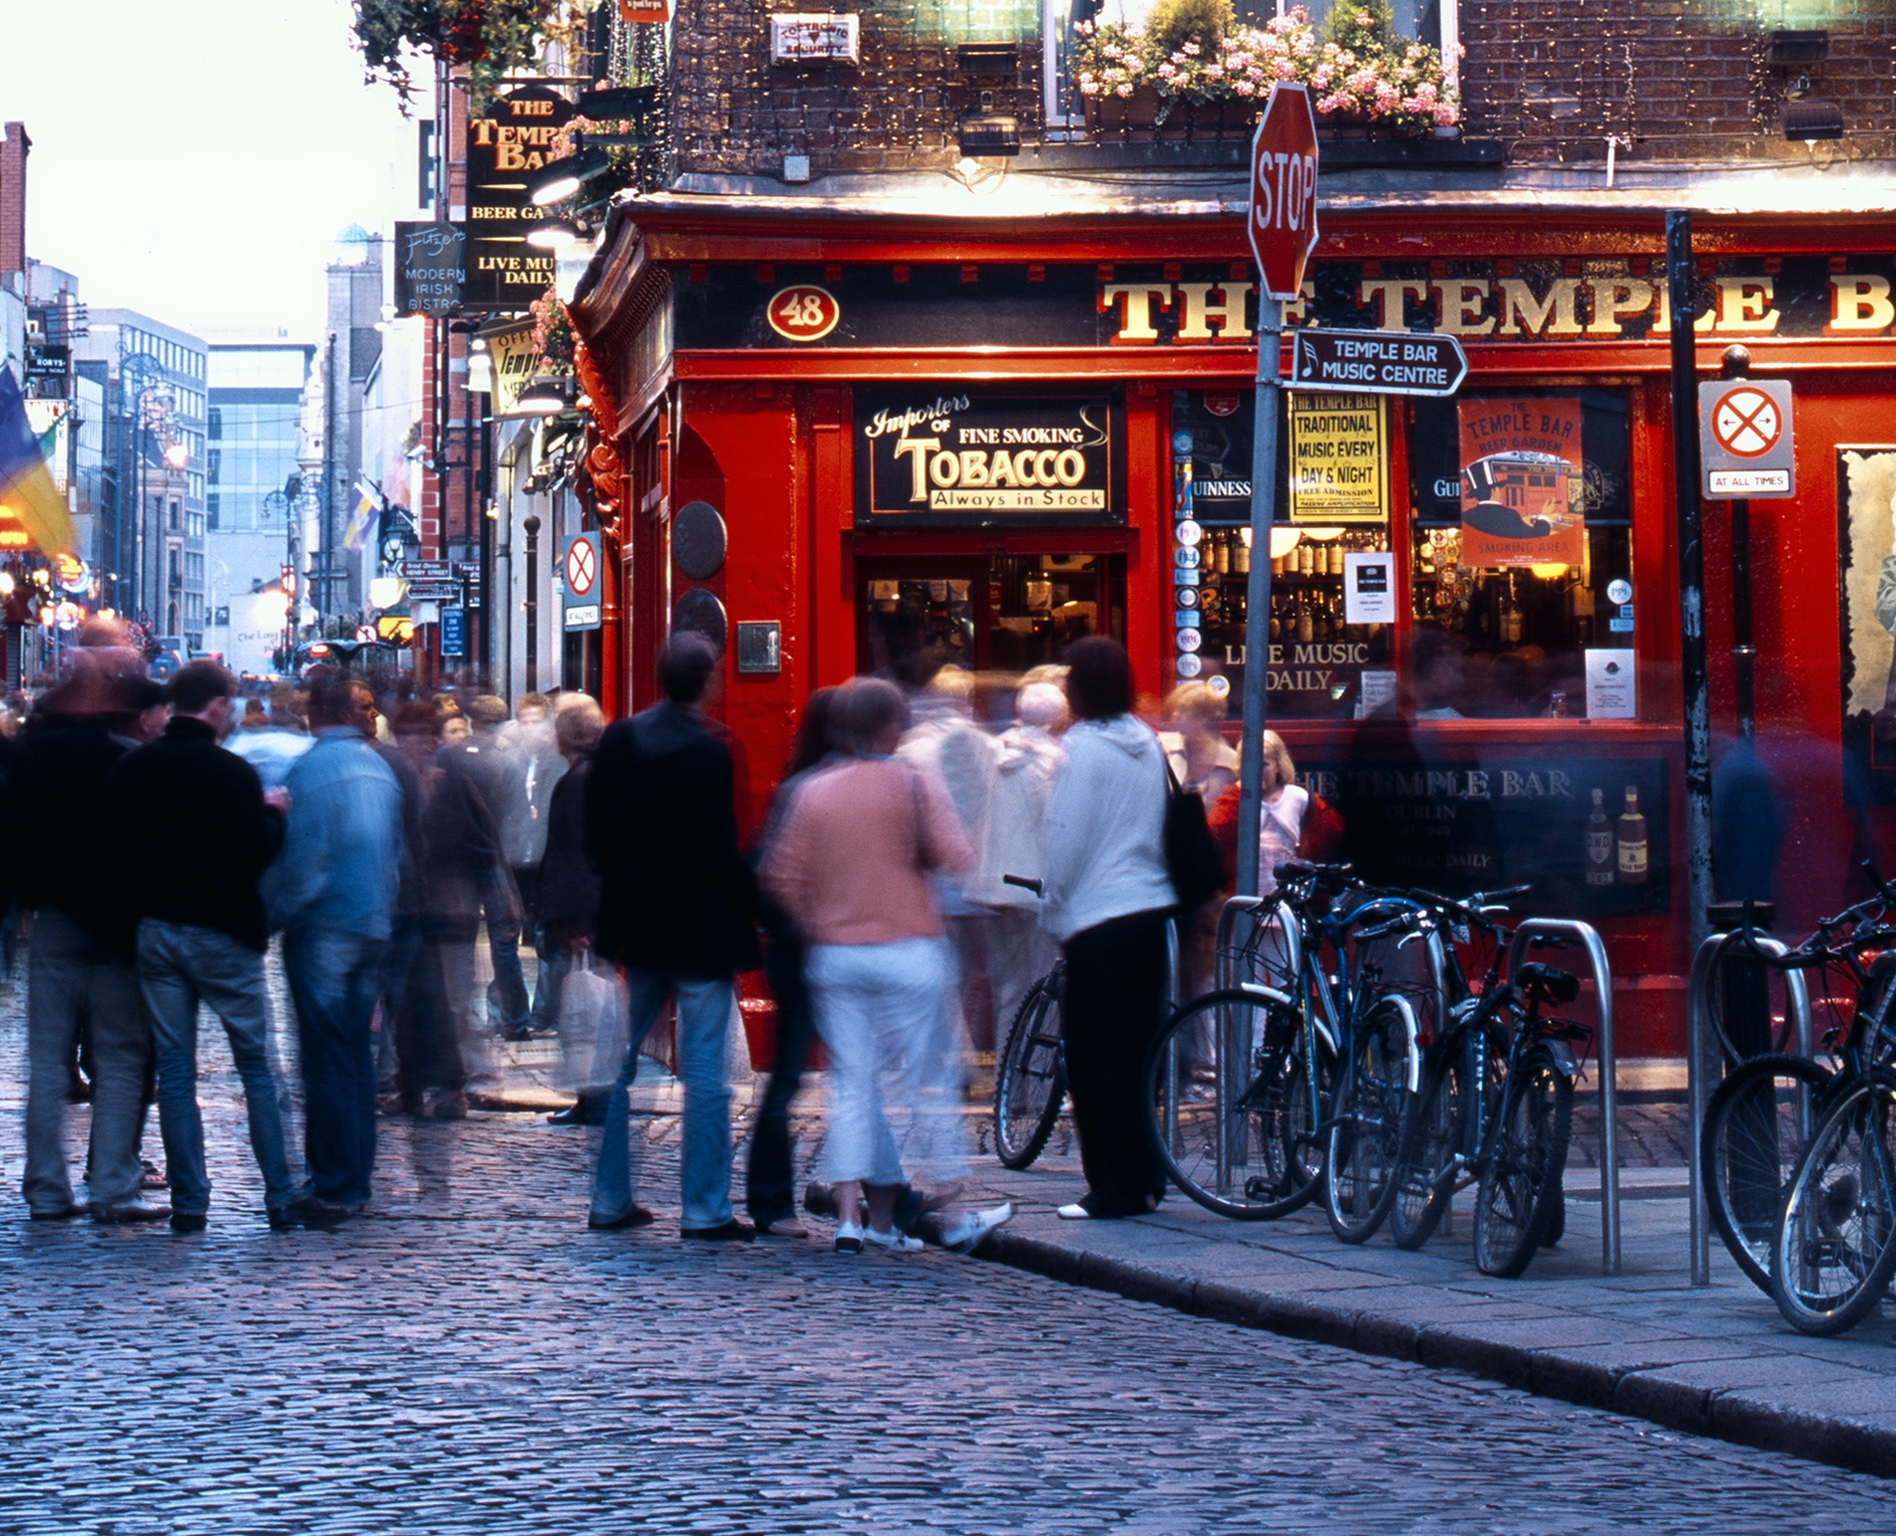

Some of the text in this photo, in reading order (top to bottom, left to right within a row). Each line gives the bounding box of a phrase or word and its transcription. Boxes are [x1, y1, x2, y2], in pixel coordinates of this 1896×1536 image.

[786, 44, 844, 55] SECURITY
[510, 100, 554, 116] THE
[470, 118, 560, 146] TEMP
[495, 144, 554, 171] BA
[1255, 150, 1316, 232] STOP
[472, 206, 517, 220] BEER
[478, 257, 522, 271] LIVE
[406, 269, 466, 280] MODERN
[505, 272, 556, 285] DAILY
[416, 284, 453, 295] IRISH
[779, 293, 824, 327] 48
[1362, 277, 1781, 335] TEMPLE
[1334, 341, 1438, 363] TEMPLE BAR
[1322, 361, 1448, 385] MUSIC CENTRE
[1293, 395, 1377, 410] THE TEMPLE BAR
[1511, 402, 1527, 412] THE
[865, 394, 971, 438] Importers
[1297, 415, 1373, 433] TRADITIONAL
[931, 420, 951, 433] OF
[1467, 413, 1574, 440] TEMPLE BAR
[959, 427, 1083, 445] FINE SMOKING
[1298, 441, 1375, 458] MUSIC EVERY
[1479, 436, 1563, 455] BEER GARDEN
[894, 437, 1086, 502] TOBACCO
[1302, 467, 1373, 484] DAY & NIGHT
[1193, 481, 1252, 496] UINNESS
[1715, 475, 1784, 487] AT ALL TIMES
[934, 489, 1102, 508] Always in Stock
[1298, 488, 1373, 497] FREE ADMISSION
[1478, 542, 1569, 554] SMOKING AREA
[1225, 643, 1369, 665] LIE MUSIC
[1264, 670, 1333, 691] DAILY
[1298, 769, 1570, 798] HE TEMPLE BAR
[1444, 853, 1492, 869] DAILY
